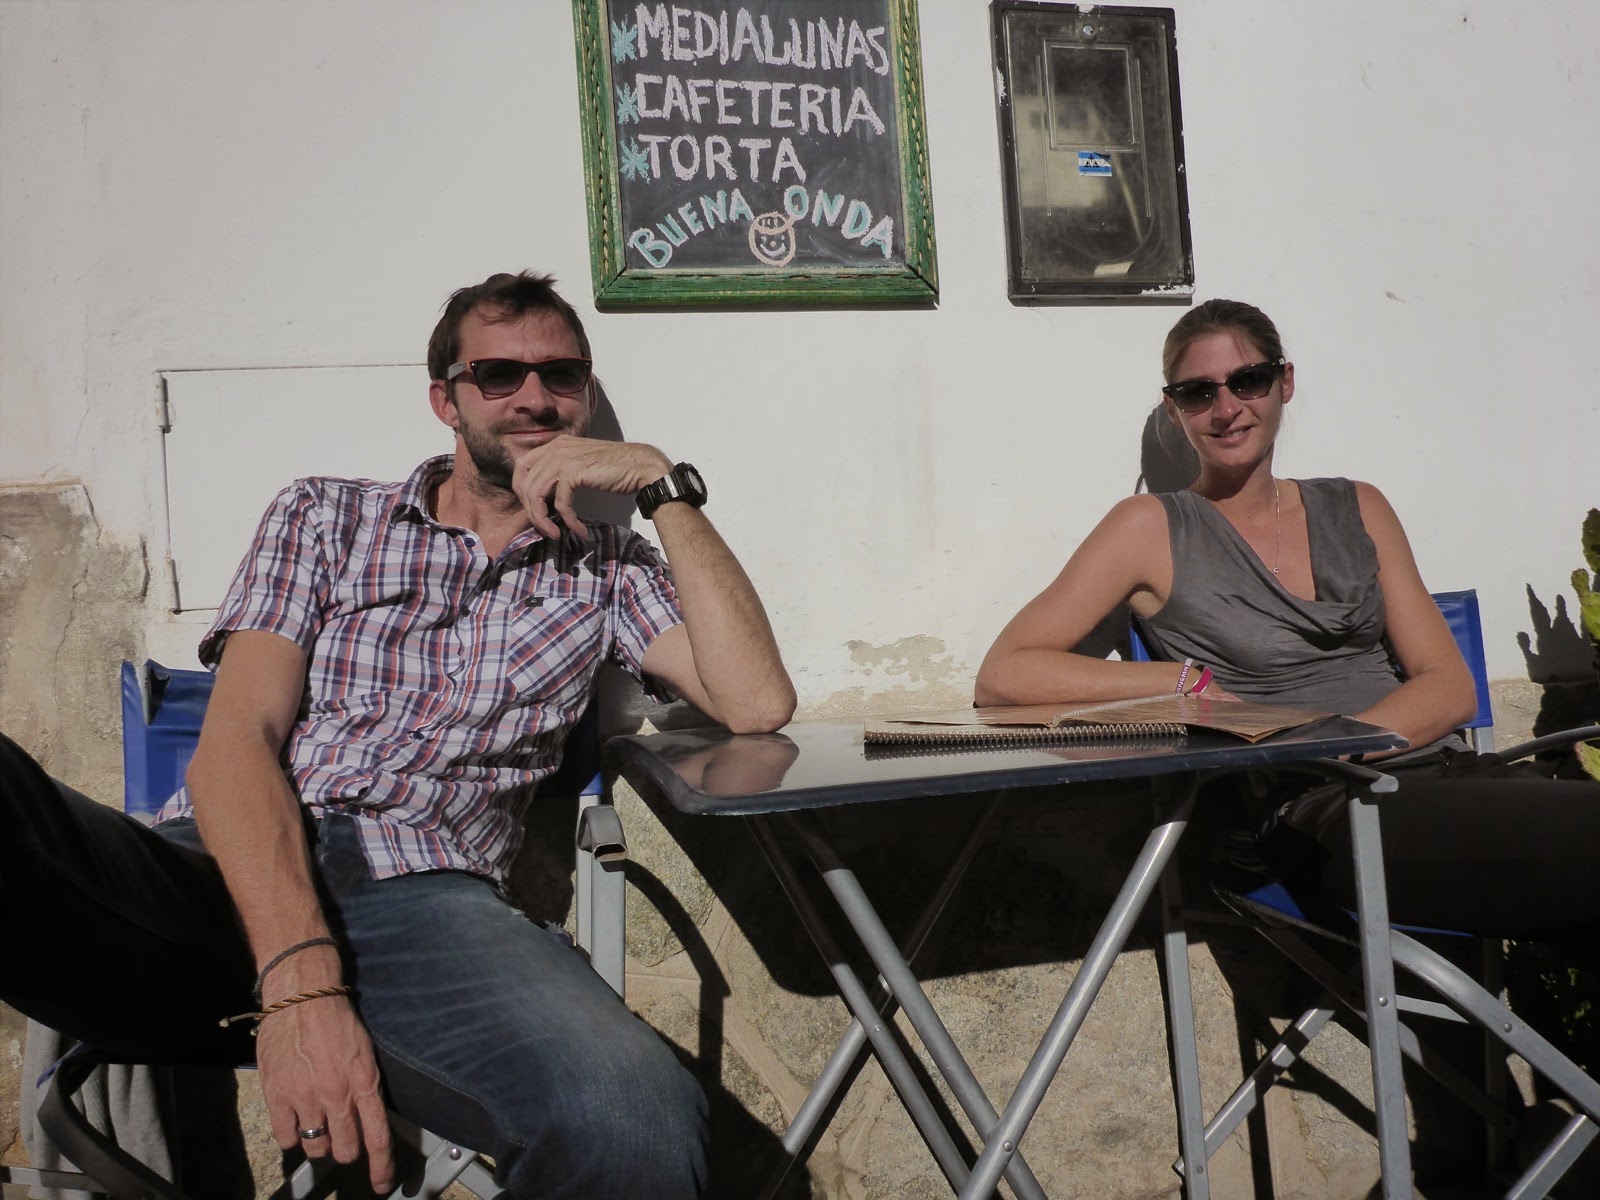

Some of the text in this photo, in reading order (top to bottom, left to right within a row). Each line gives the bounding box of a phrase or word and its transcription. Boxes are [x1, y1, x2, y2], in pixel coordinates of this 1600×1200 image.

[635, 3, 889, 76] MEDIALUNAS
[635, 74, 885, 137] CAFETERIA
[637, 134, 806, 183] TORTA
[628, 185, 895, 268] BUENA ONDA
